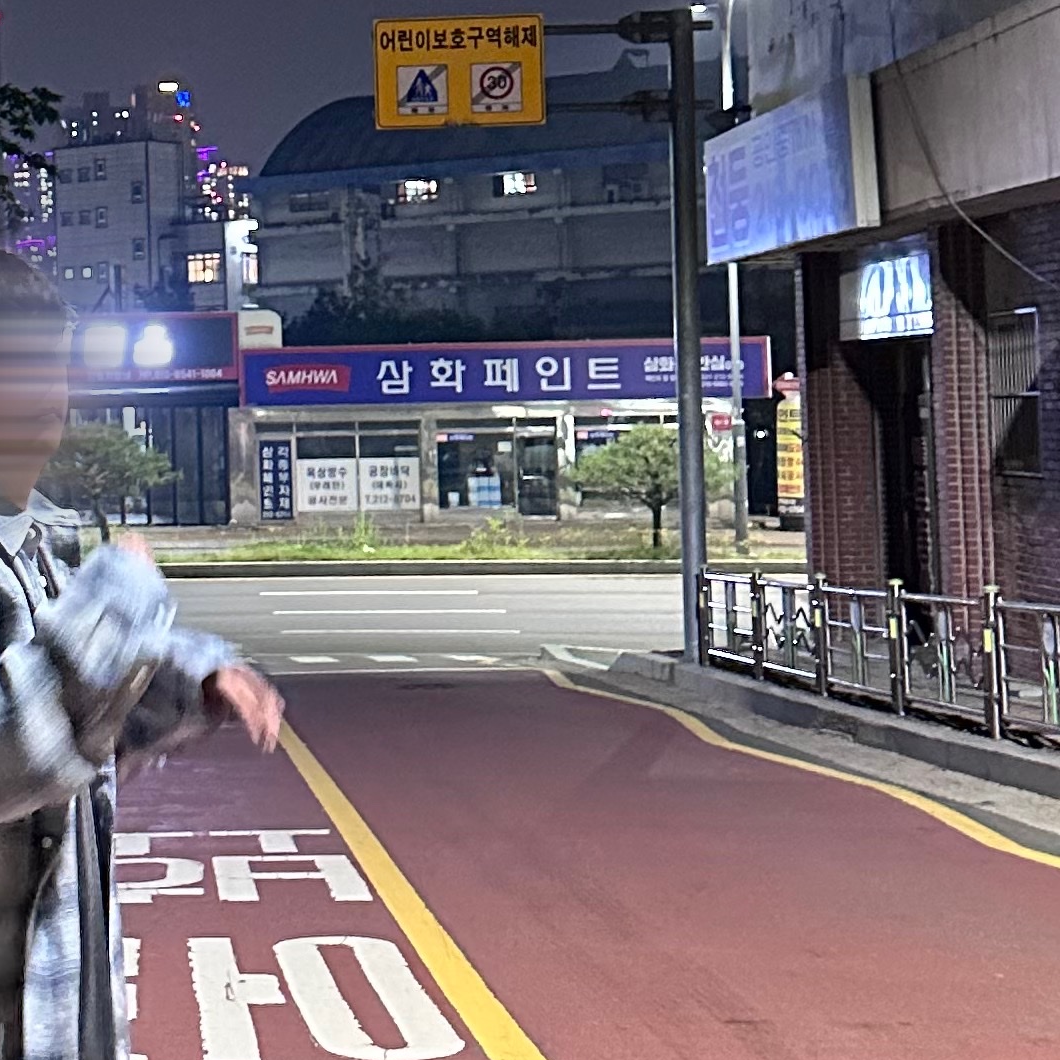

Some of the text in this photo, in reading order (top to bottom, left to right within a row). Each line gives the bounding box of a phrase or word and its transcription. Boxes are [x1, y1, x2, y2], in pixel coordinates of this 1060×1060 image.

[380, 25, 538, 52] 어린이보호구역해제
[487, 75, 508, 90] 30
[265, 368, 338, 387] SAMHWA
[376, 356, 622, 395] 삼화페인트
